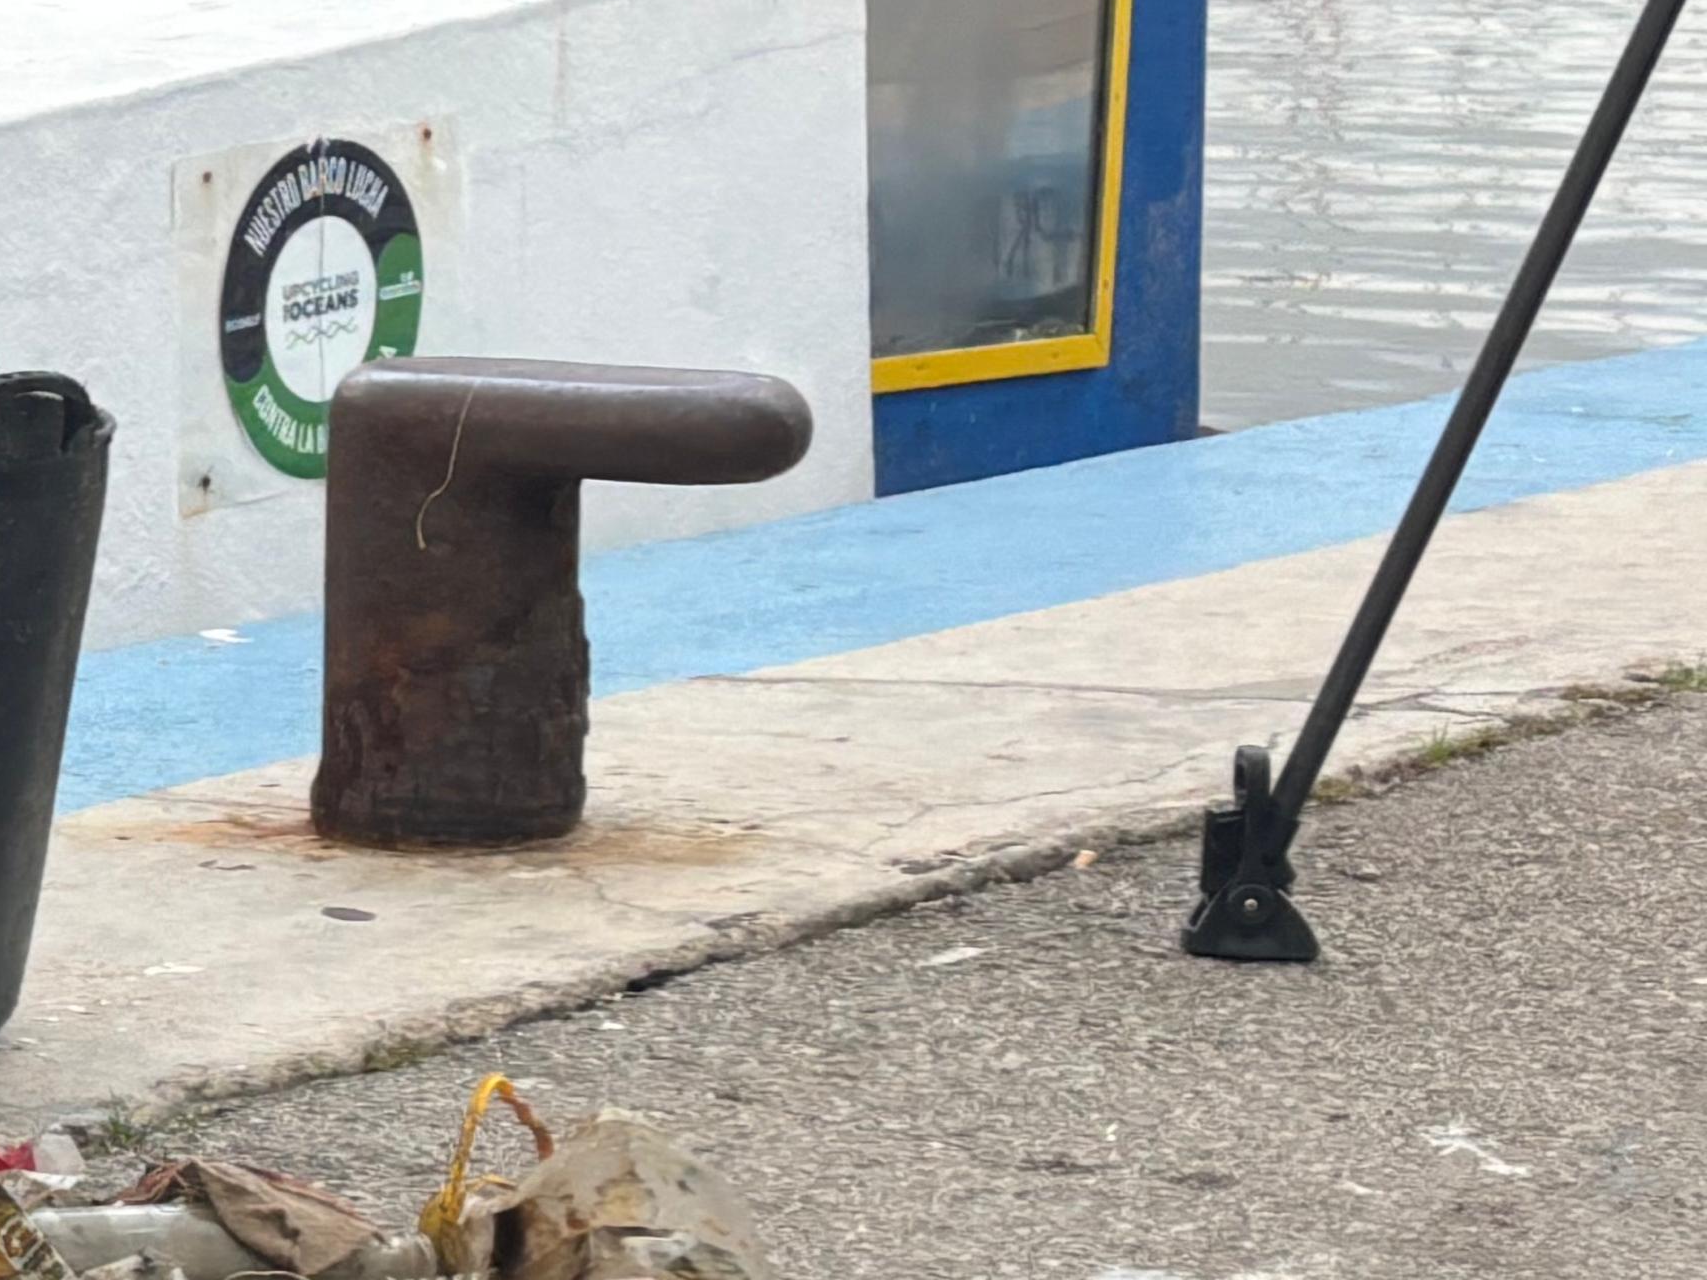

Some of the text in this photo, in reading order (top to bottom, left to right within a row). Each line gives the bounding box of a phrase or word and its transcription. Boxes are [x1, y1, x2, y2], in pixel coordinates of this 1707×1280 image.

[243, 155, 389, 258] NUESTRO BARCO LUCHA
[282, 270, 360, 301] UPCYCLING
[290, 288, 360, 320] OCEANS
[252, 383, 298, 450] CONTRA
[297, 423, 314, 454] LA
